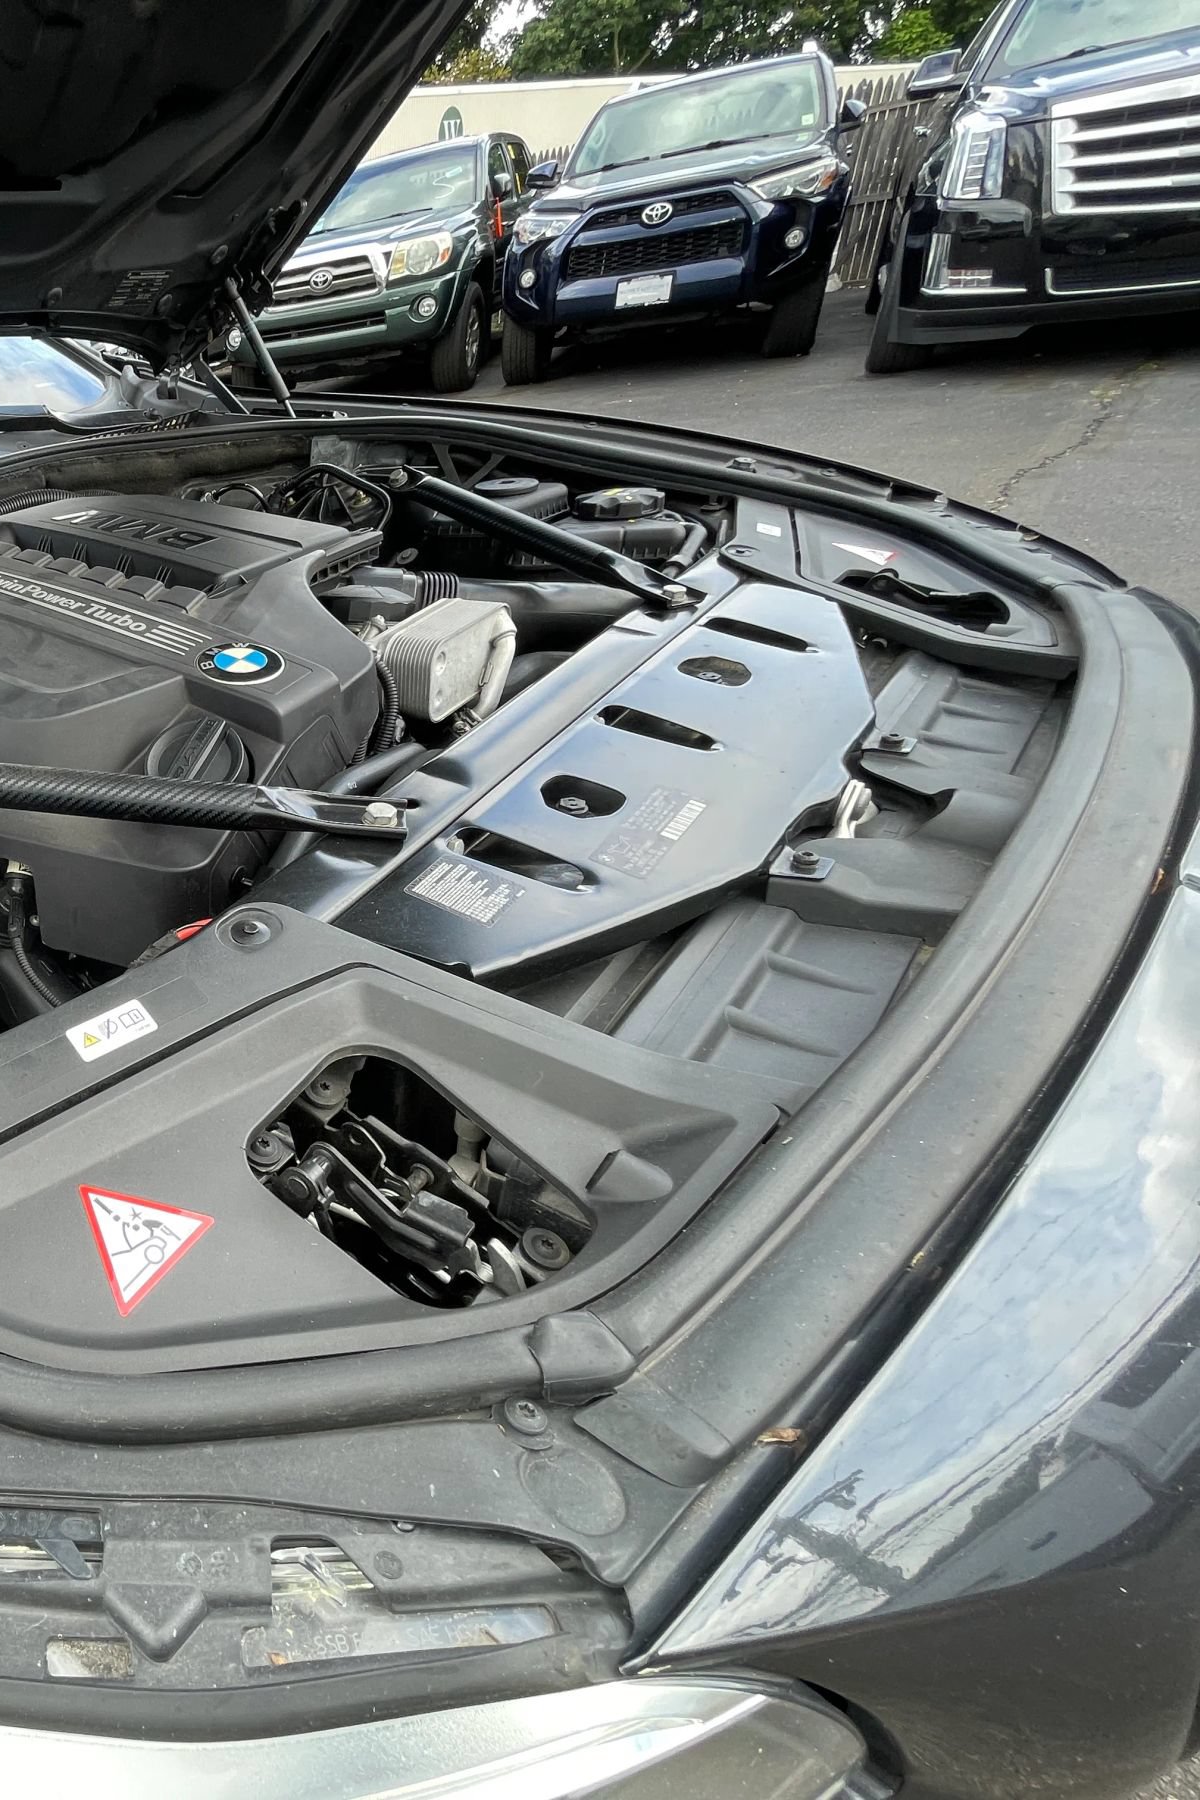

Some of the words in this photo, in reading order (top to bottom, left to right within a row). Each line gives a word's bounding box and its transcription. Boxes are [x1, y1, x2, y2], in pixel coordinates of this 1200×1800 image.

[443, 119, 460, 140] W
[51, 510, 219, 550] BMW
[83, 602, 147, 632] Turbo
[200, 642, 250, 670] BMW
